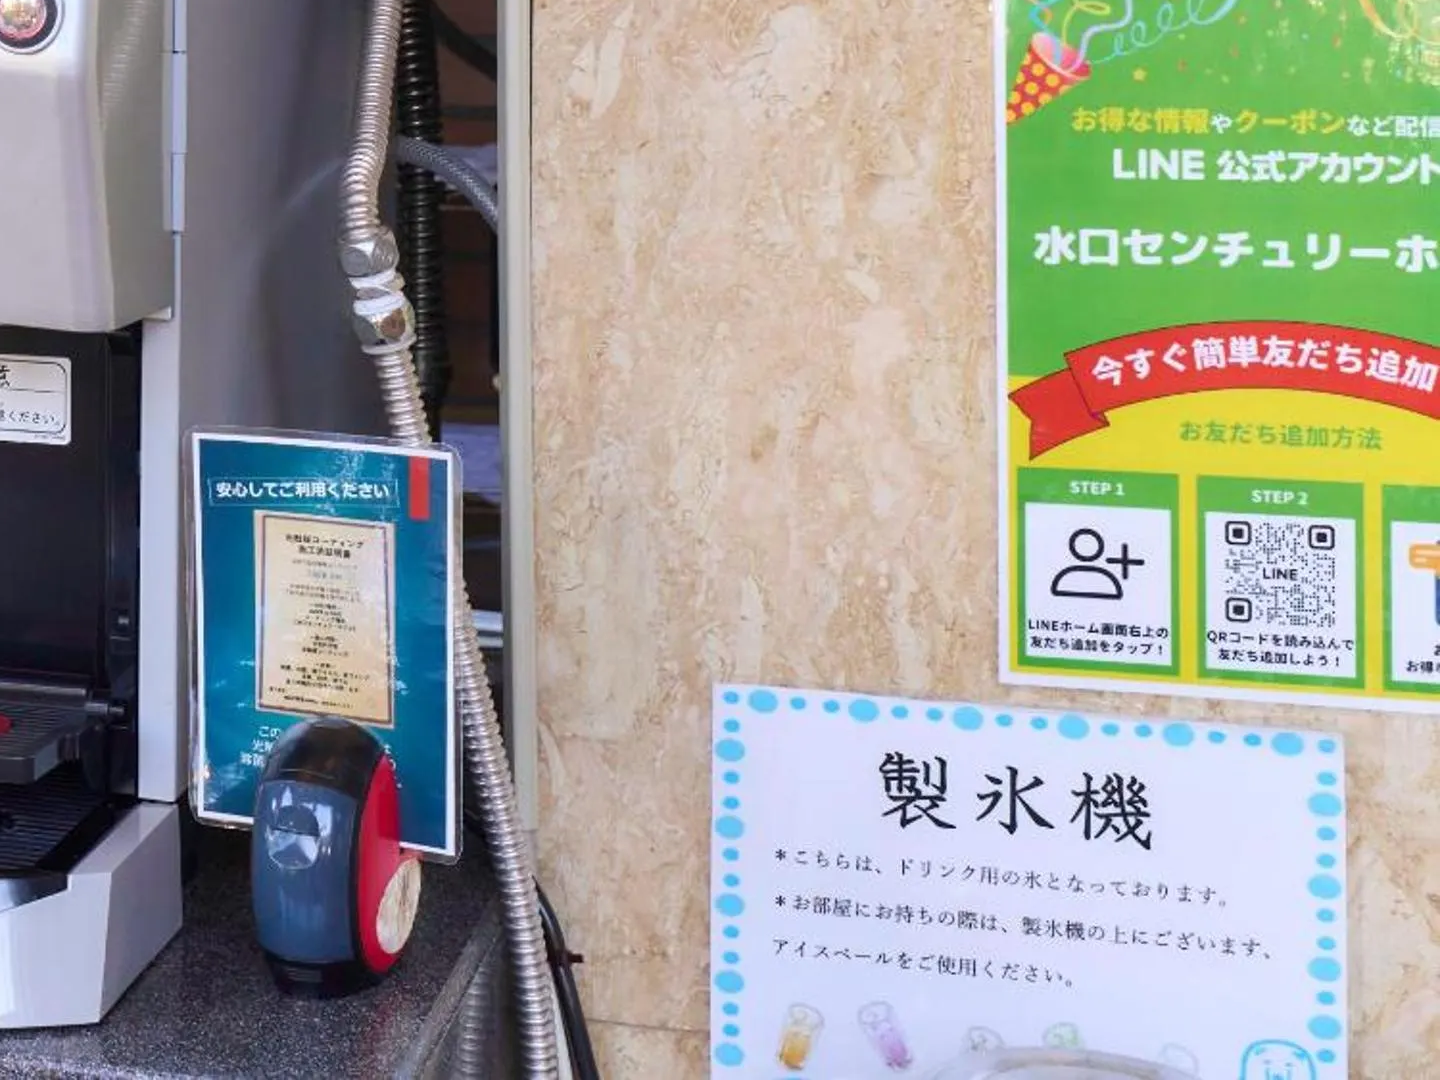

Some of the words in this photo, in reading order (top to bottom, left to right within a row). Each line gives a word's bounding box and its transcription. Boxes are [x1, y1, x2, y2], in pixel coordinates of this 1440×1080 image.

[1112, 148, 1206, 181] LINE
[1216, 150, 1440, 186] 公式アカウント
[1033, 225, 1439, 274] 水口センチュリーホ
[1091, 334, 1438, 394] 今すぐ簡単友だち追加
[1178, 420, 1383, 451] お友だち追加方法
[215, 480, 390, 500] 安心してご利用ください
[1069, 480, 1113, 497] STEP
[1116, 482, 1125, 497] 1
[1251, 488, 1295, 505] STEP
[1298, 491, 1310, 506] 2
[1262, 568, 1299, 582] LINE
[1028, 619, 1169, 640] LINEホーム画面右上の
[1206, 629, 1355, 651] QRコードを読み込んで
[878, 750, 1155, 851] 製氷機
